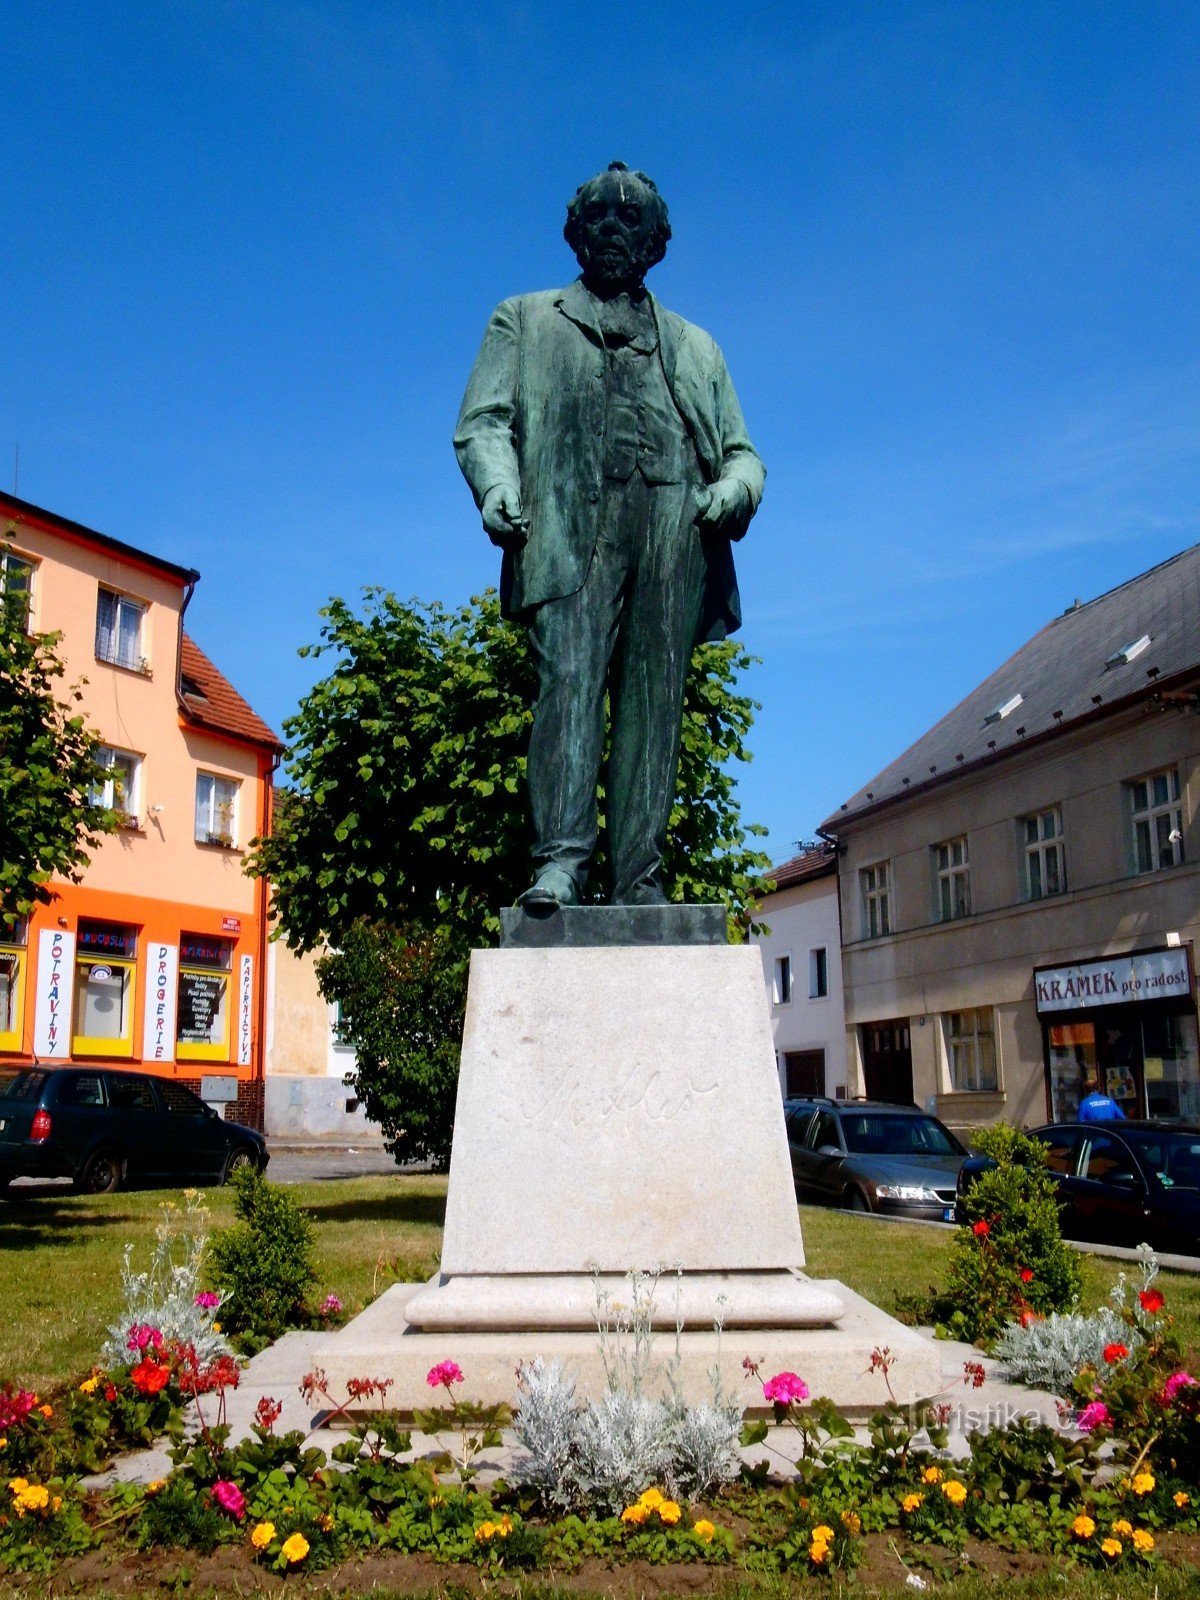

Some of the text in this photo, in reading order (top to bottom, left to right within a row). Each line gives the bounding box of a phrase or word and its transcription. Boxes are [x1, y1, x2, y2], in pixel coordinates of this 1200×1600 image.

[47, 933, 63, 1055] POTRAVINY
[154, 947, 168, 1059] DROGERIE
[1037, 969, 1188, 1001] KRÁMEK pro radost
